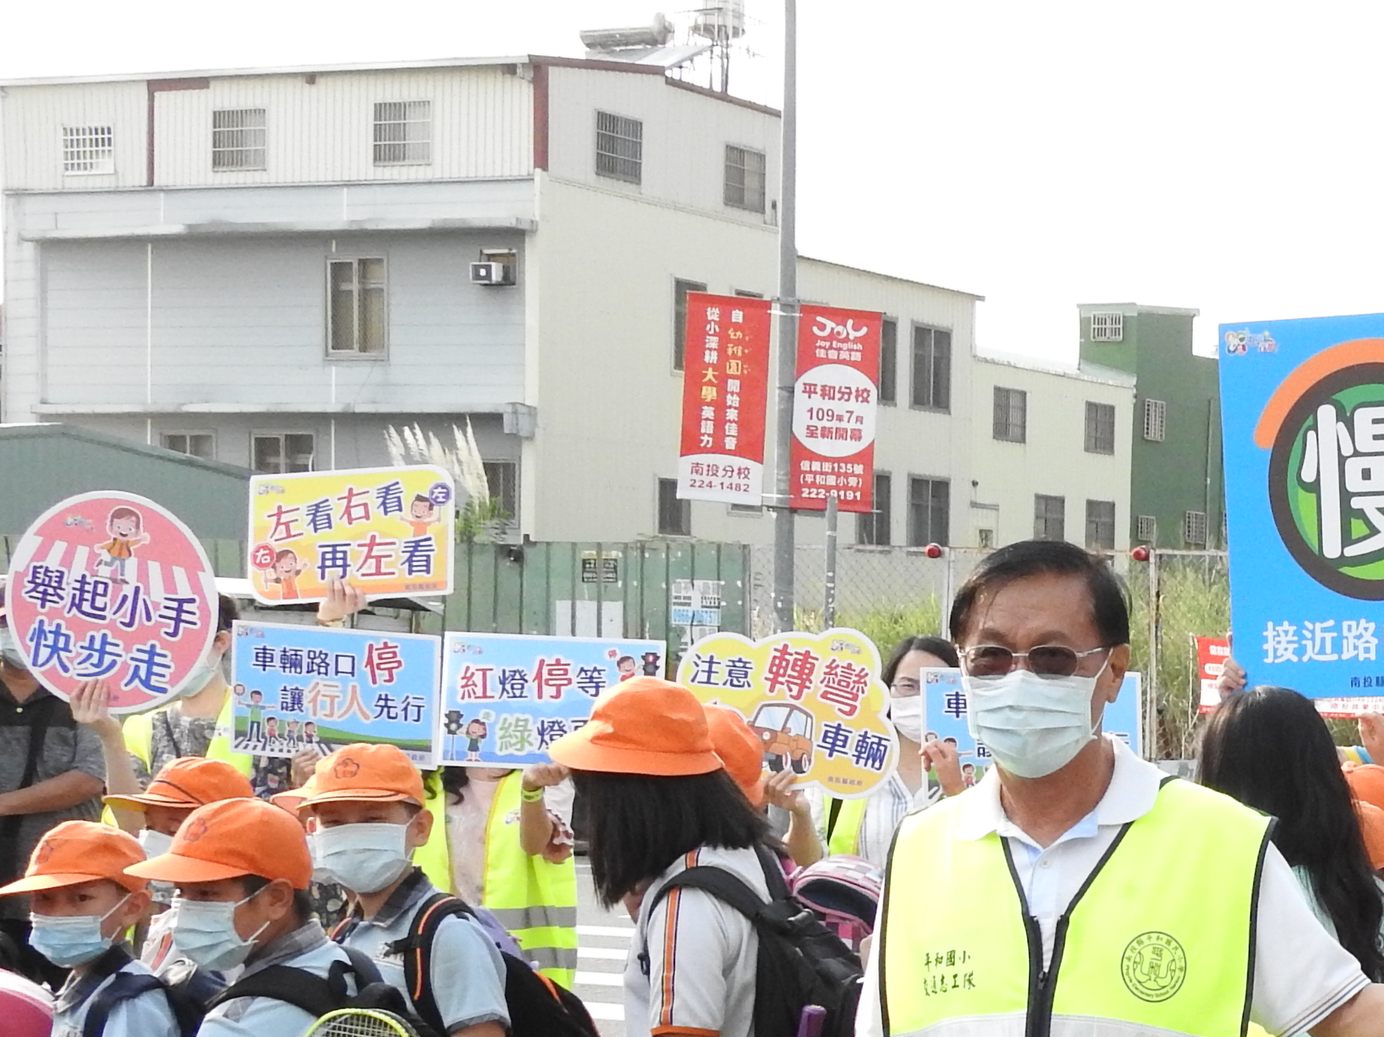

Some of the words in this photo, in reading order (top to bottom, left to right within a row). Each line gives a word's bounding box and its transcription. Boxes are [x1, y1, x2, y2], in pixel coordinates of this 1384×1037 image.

[815, 339, 831, 349] Joy
[832, 340, 863, 351] English
[802, 382, 871, 404] 平和分校
[805, 425, 863, 442] 全新開幕
[806, 406, 864, 425] 109年7月
[689, 461, 751, 481] 南投分校
[689, 478, 750, 493] 224-1482
[266, 480, 404, 542] 左看右看
[432, 488, 446, 502] 左
[254, 550, 271, 564] 右
[317, 534, 436, 581] 再左看
[26, 563, 200, 639] 舉起小手
[28, 618, 173, 695] 快步走
[252, 642, 403, 687] 車輛路口停
[459, 658, 607, 700] 紅燈停等
[690, 643, 870, 718] 注意轉彎
[280, 681, 426, 724] 讓行人先行
[816, 722, 891, 773] 車輛
